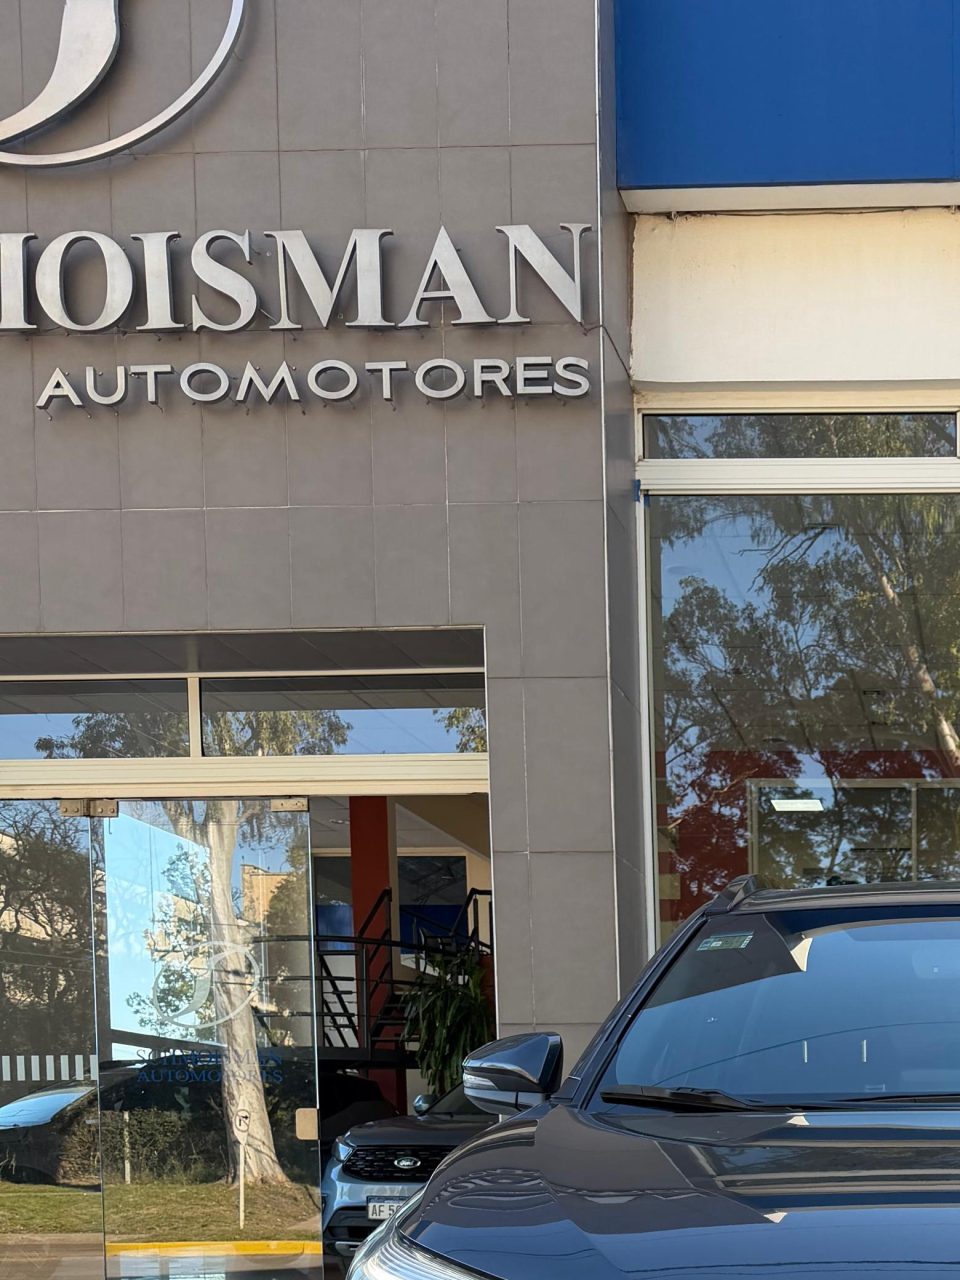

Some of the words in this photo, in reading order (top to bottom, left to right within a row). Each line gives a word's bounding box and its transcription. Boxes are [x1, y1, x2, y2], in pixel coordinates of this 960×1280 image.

[0, 223, 593, 333] OISMAN
[36, 357, 591, 408] AUTOMOTORES
[371, 1204, 385, 1217] AF
